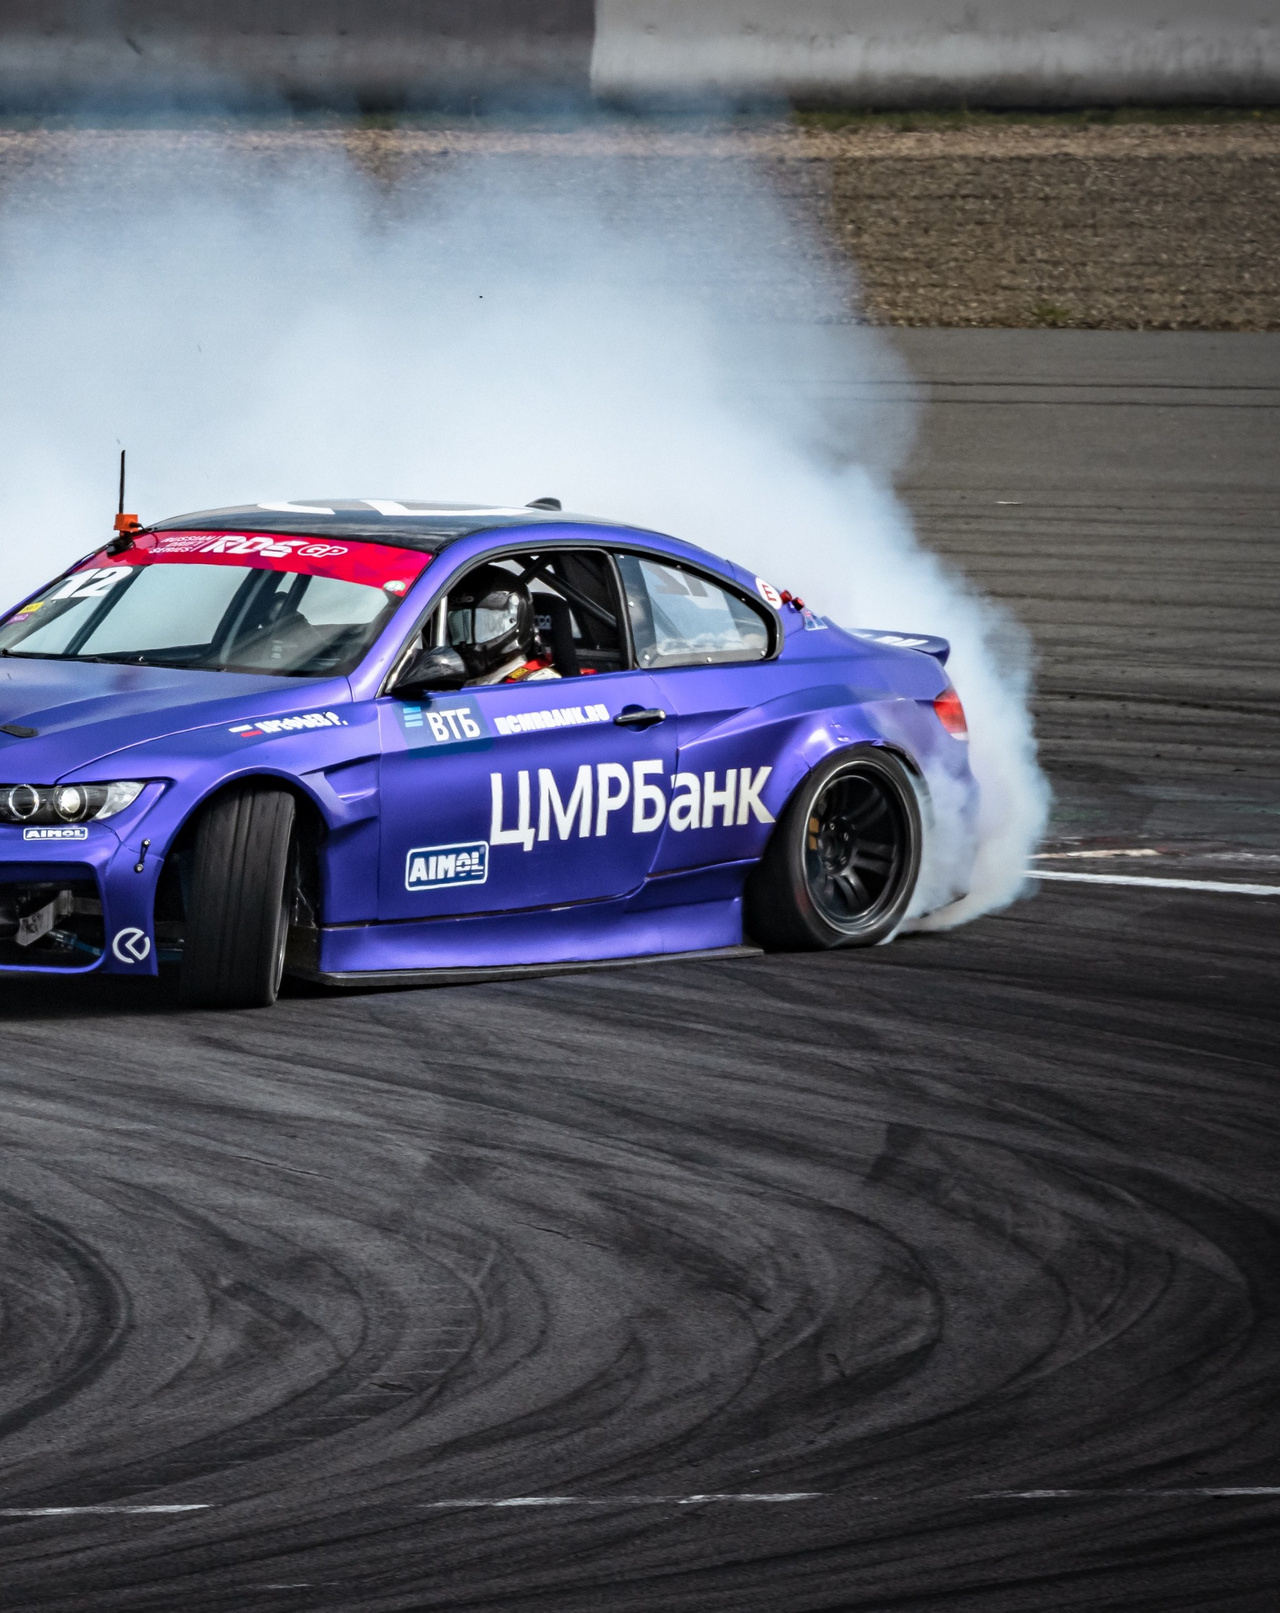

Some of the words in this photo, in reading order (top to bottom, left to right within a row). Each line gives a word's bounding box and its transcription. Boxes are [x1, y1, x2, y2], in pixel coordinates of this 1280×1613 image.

[199, 535, 310, 558] RDS
[297, 544, 349, 558] GP
[51, 566, 134, 600] 12
[426, 707, 481, 742] ВТБ
[489, 758, 776, 852] ЦМРБанк
[409, 851, 484, 882] AIMOL
